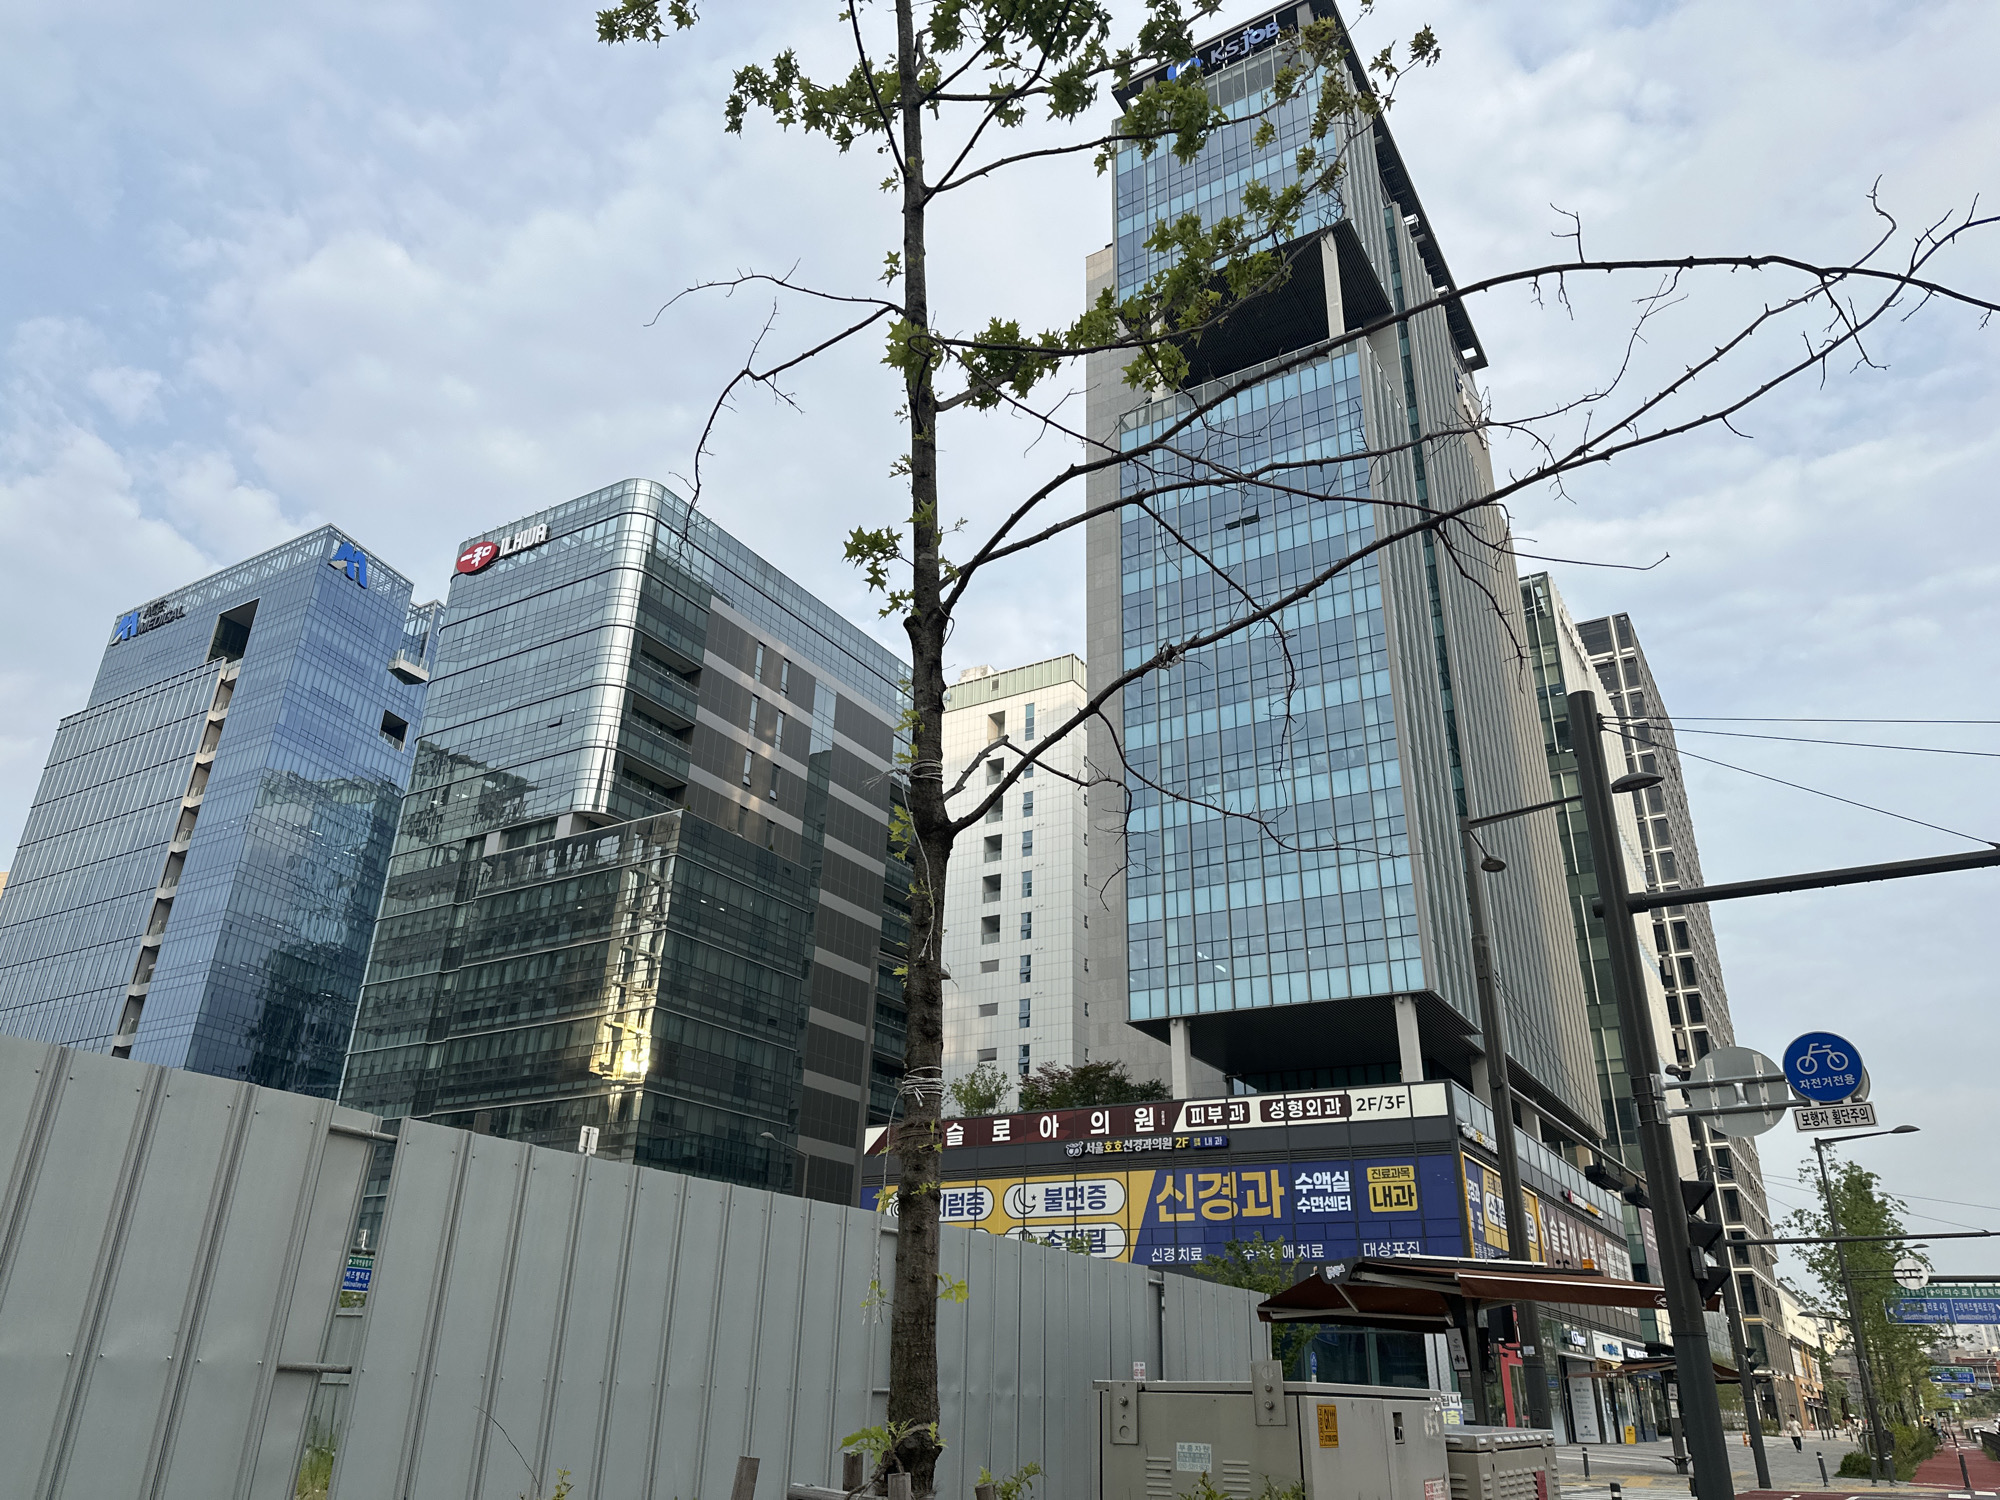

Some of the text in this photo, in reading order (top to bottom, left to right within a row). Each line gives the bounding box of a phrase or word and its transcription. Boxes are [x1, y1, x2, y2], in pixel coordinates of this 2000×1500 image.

[499, 523, 548, 556] ILHWA
[139, 605, 186, 635] MEDICAL
[1798, 1073, 1856, 1090] 자전거전용
[1190, 1103, 1246, 1125] 피부과
[1268, 1096, 1342, 1120] 성형외과
[1356, 1094, 1406, 1113] 2F/3F
[1802, 1106, 1870, 1127] 보행자 횡단주의
[1175, 1137, 1190, 1149] 2F
[1294, 1170, 1350, 1193] 수액실
[1370, 1167, 1411, 1180] 진료과목
[1043, 1184, 1107, 1213] 불면증
[1155, 1169, 1285, 1223] 신경과
[1296, 1194, 1352, 1214] 수면센터
[1371, 1184, 1416, 1209] 내과
[1151, 1247, 1203, 1263] 신경 치료
[1297, 1243, 1325, 1260] 치료
[1935, 1287, 1969, 1297] 아리수로
[1442, 1409, 1461, 1425] 1층
